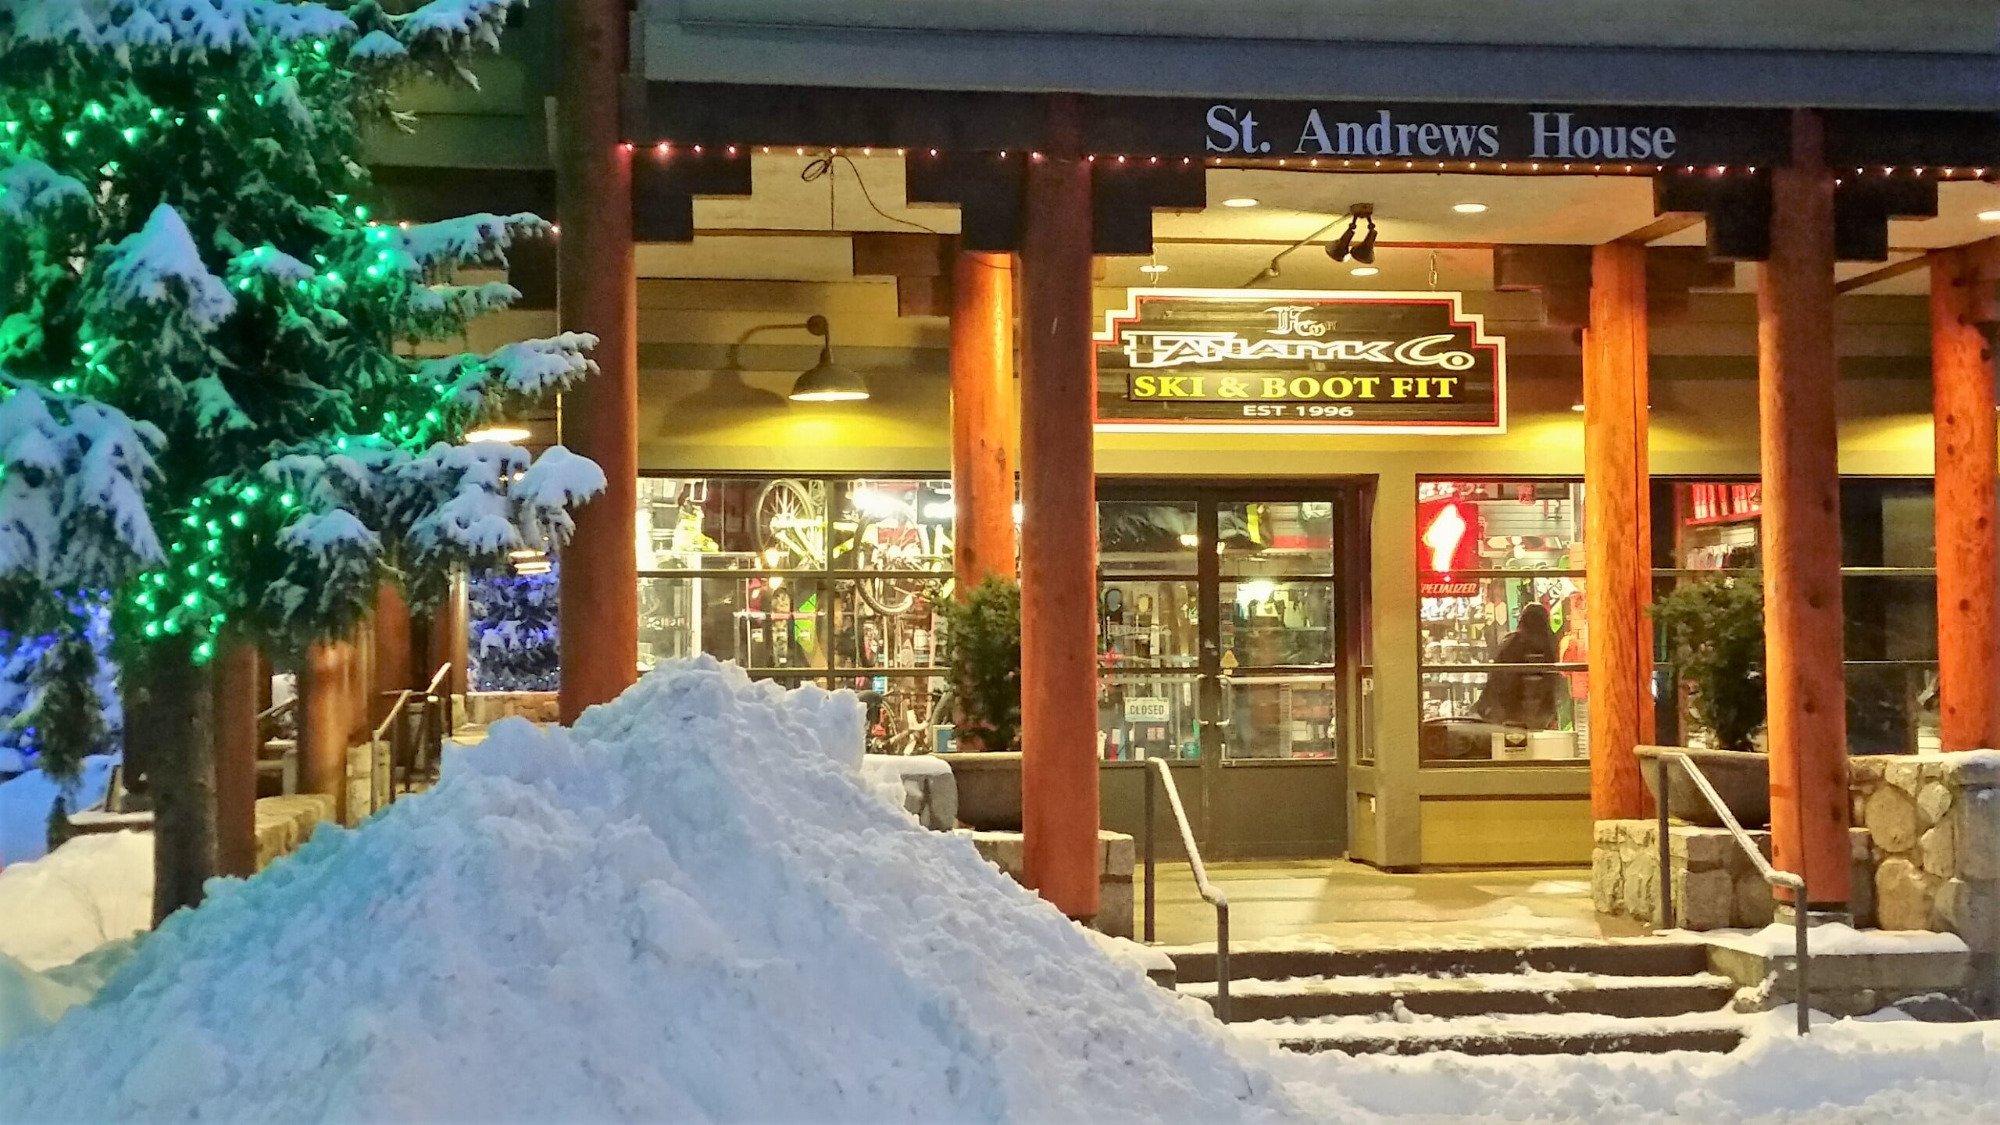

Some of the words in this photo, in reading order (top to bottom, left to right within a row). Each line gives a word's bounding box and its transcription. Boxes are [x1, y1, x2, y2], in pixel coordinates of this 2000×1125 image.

[1205, 104, 1270, 154] St.
[1293, 108, 1499, 158] Andrews
[1528, 111, 1676, 159] House
[1134, 376, 1206, 397] SKI
[1217, 376, 1250, 398] &
[1260, 377, 1380, 398] BOOT
[1390, 377, 1458, 398] FIT
[1243, 404, 1287, 417] EST
[1296, 405, 1354, 417] 1996
[1130, 704, 1164, 715] CLOSED
